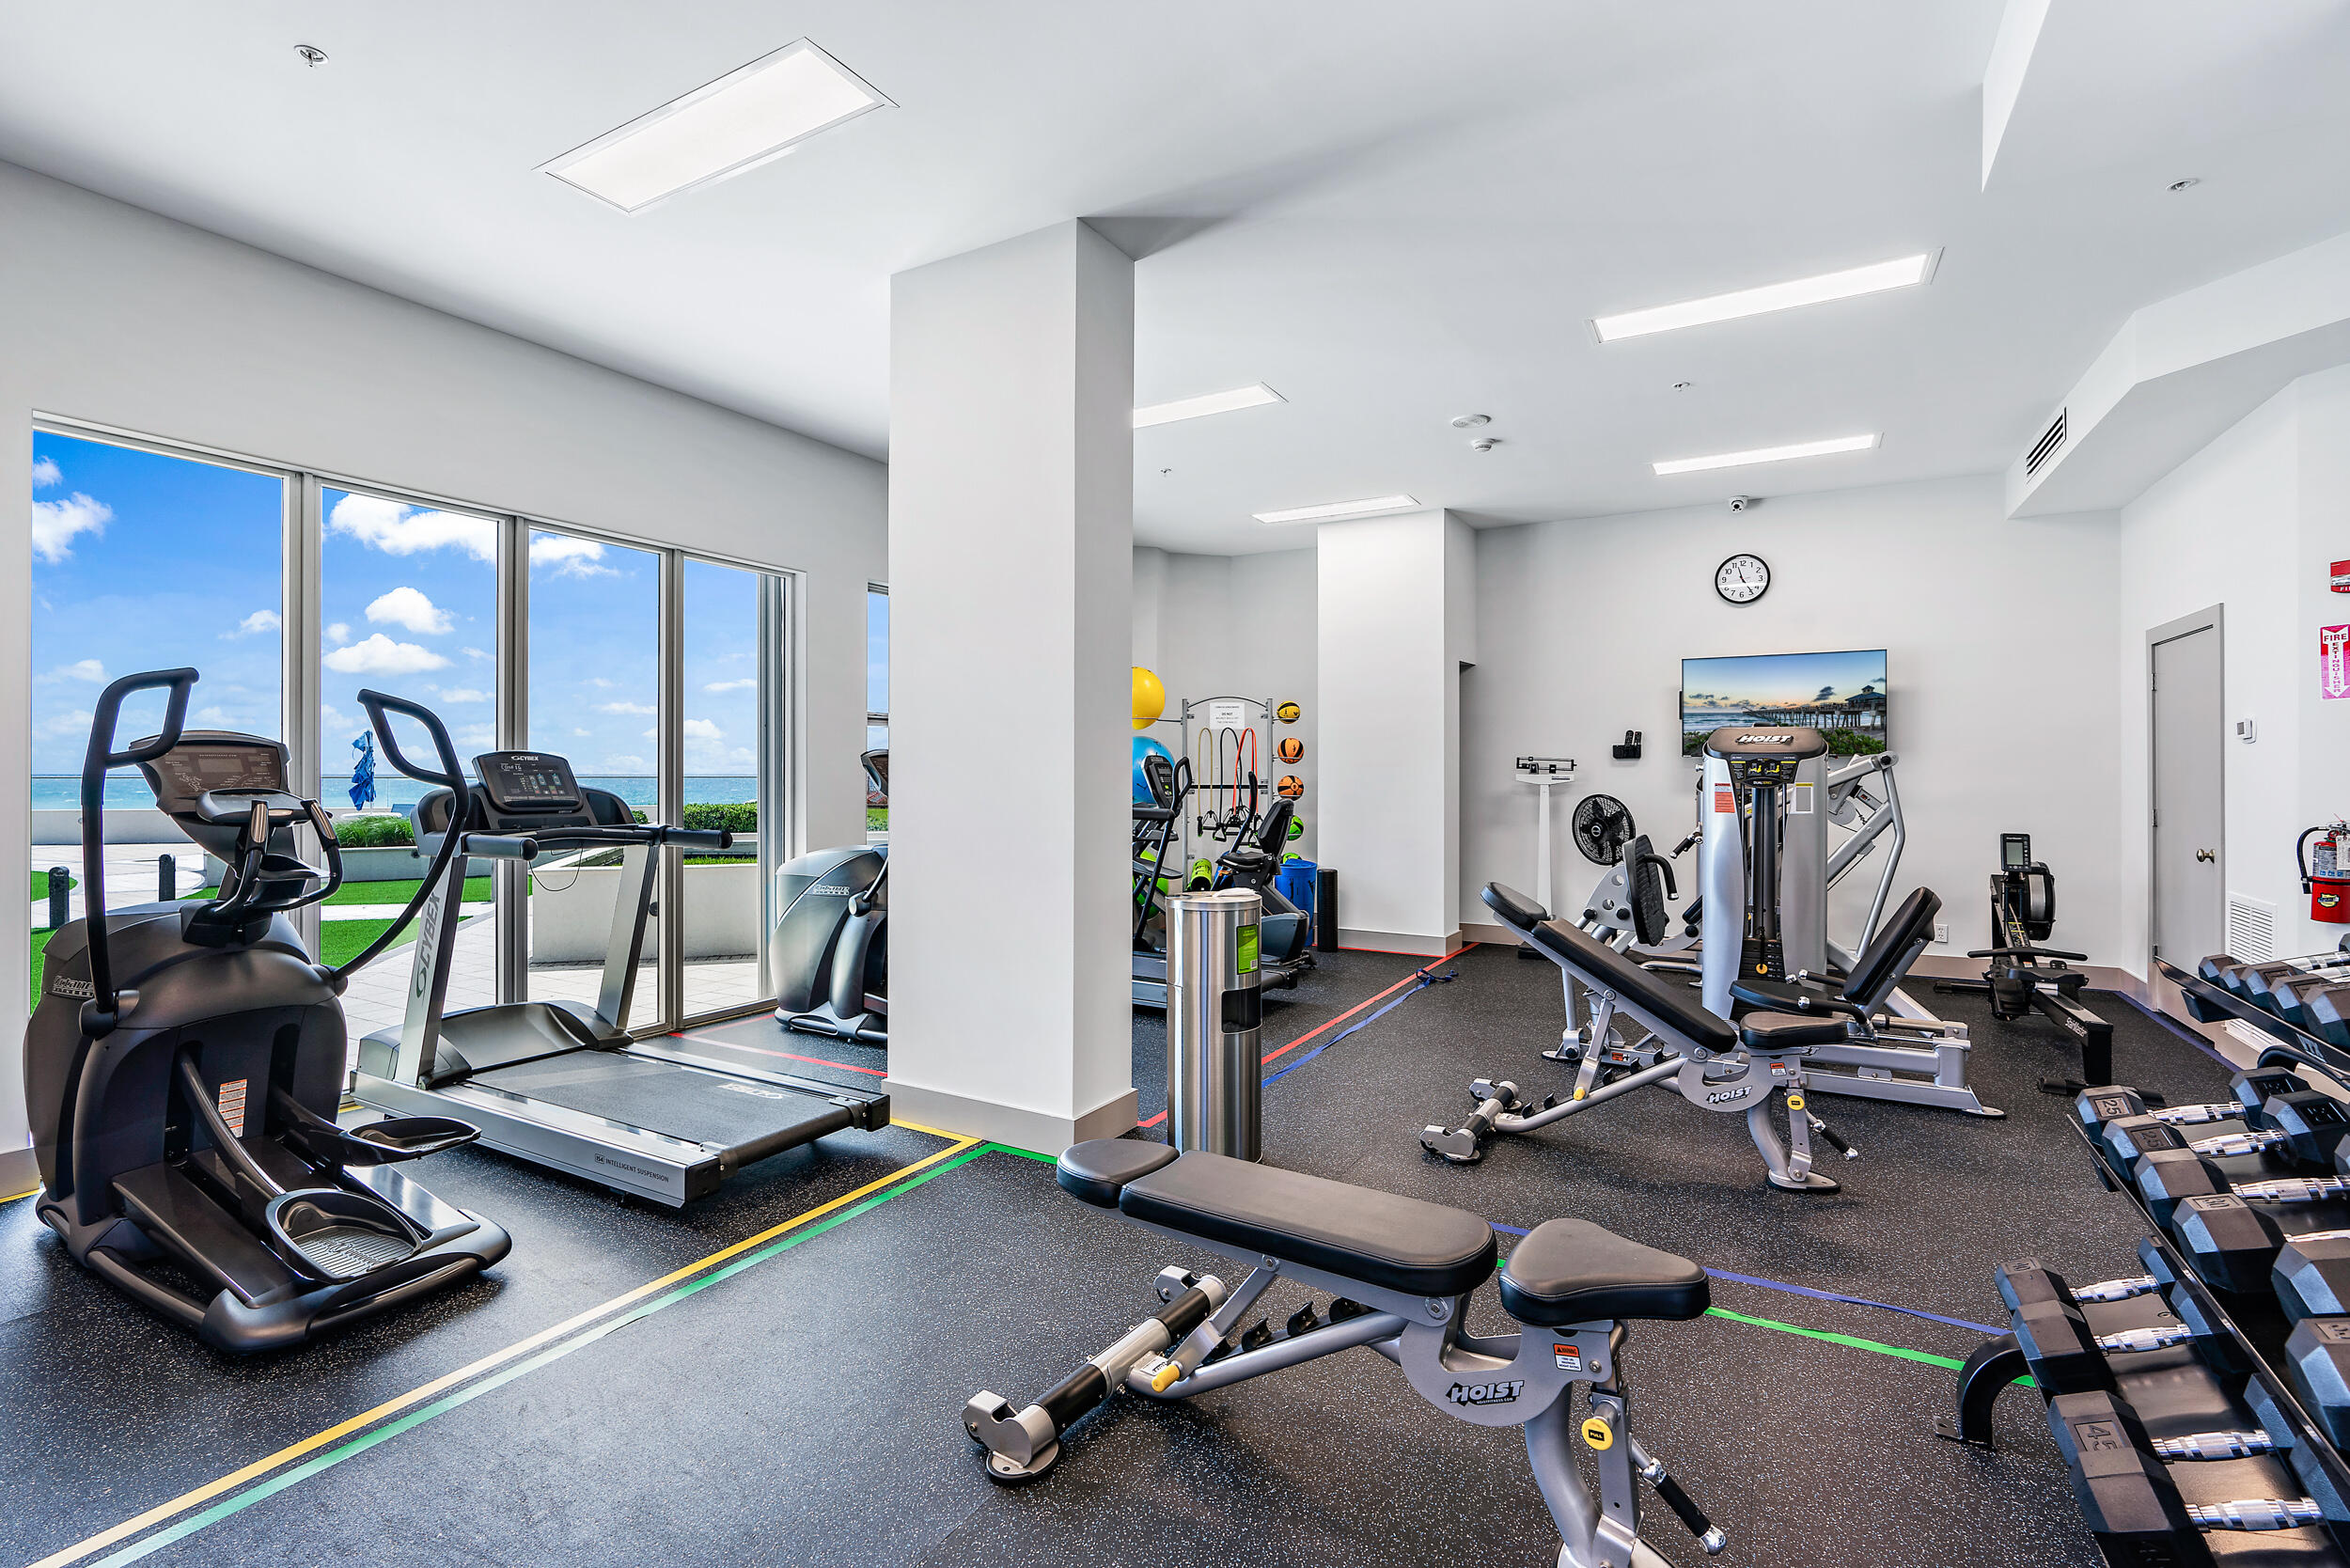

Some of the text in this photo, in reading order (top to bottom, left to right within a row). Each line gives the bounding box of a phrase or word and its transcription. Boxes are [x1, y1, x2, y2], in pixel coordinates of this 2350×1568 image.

[1738, 735, 1792, 744] HOIST
[419, 892, 440, 969] CYBEX
[1708, 1087, 1751, 1104] HOIST
[2103, 1099, 2122, 1115] 25
[605, 1158, 636, 1173] INTELLIGENT
[637, 1168, 669, 1183] SUSPENSION
[1450, 1380, 1525, 1403] HOIST
